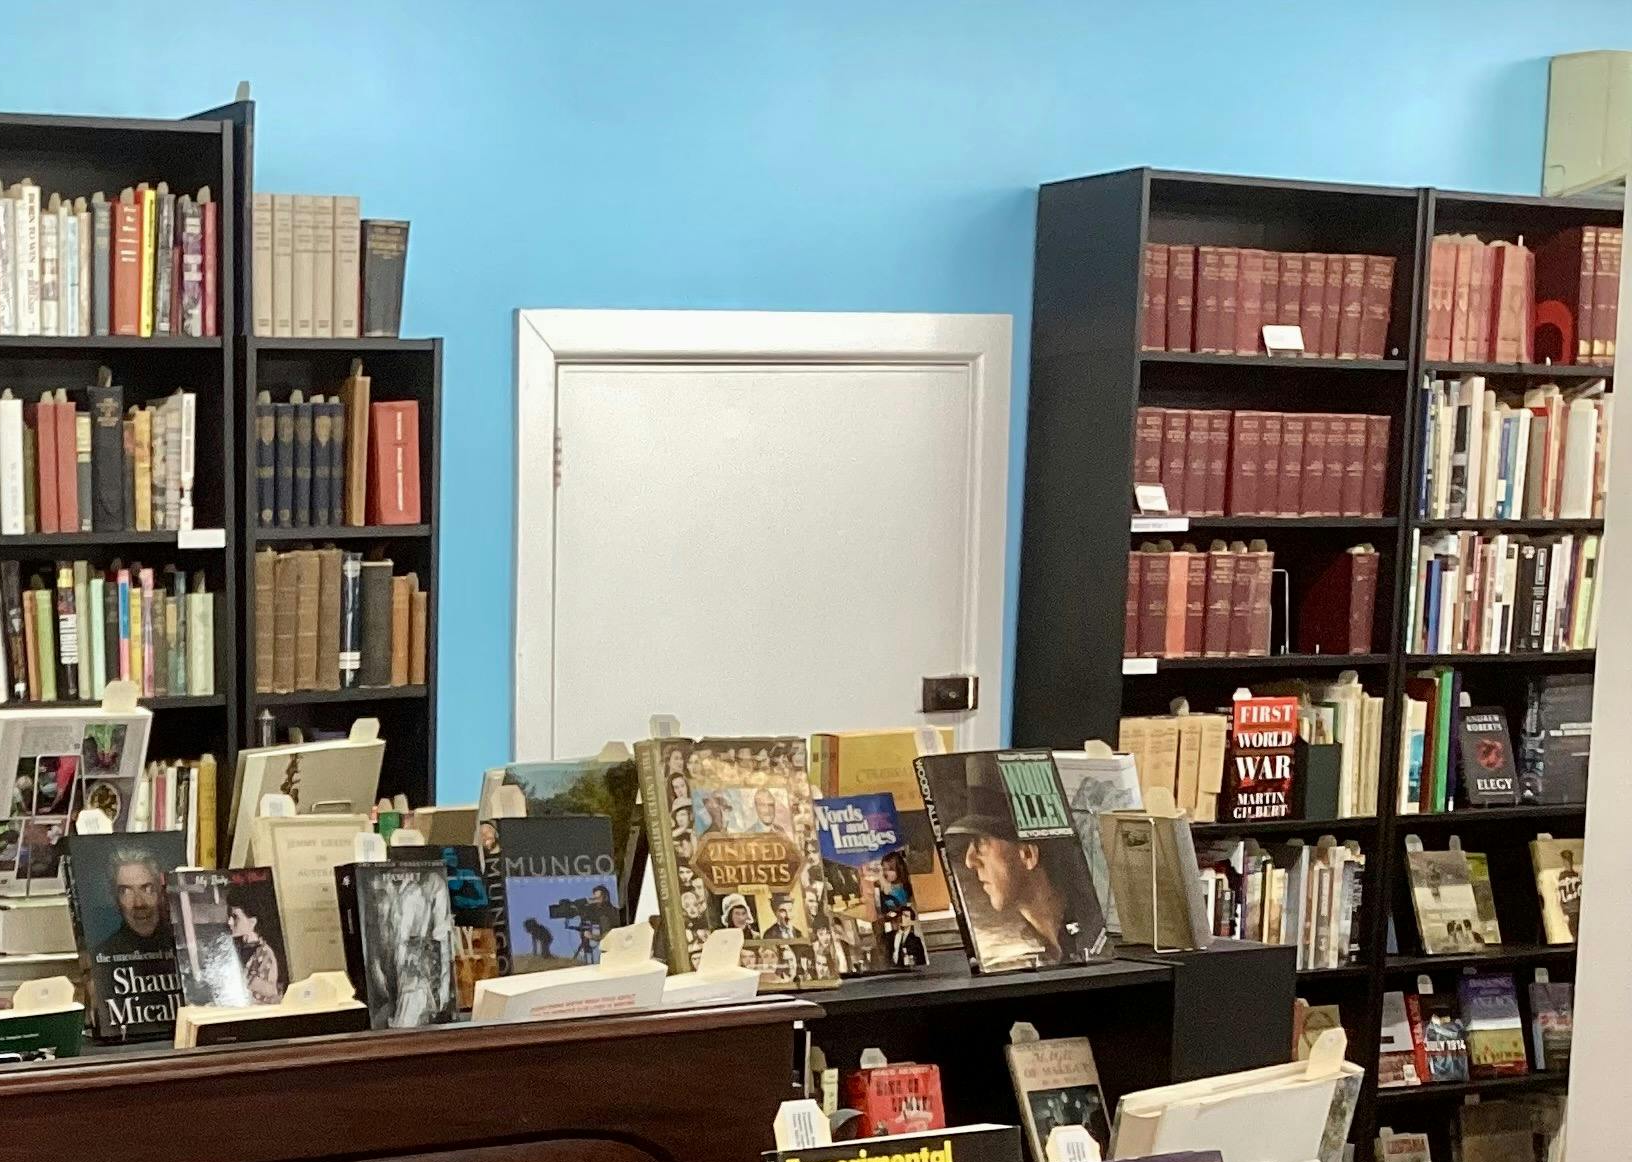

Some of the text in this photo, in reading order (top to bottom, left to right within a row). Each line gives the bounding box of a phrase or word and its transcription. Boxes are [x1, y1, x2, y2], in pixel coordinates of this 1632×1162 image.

[1240, 705, 1293, 723] FIRST
[1238, 731, 1293, 748] WORLD
[1236, 756, 1291, 780] WAR
[916, 760, 932, 801] WOODY
[1477, 778, 1513, 790] ELEGY
[1237, 792, 1285, 805] MARTIN
[813, 804, 863, 831] Words
[1233, 805, 1288, 819] GILBERT
[830, 824, 896, 851] Images
[710, 842, 786, 861] UNITED
[505, 854, 615, 876] MUNGO
[712, 864, 790, 884] ARTISTS
[96, 952, 111, 963] the
